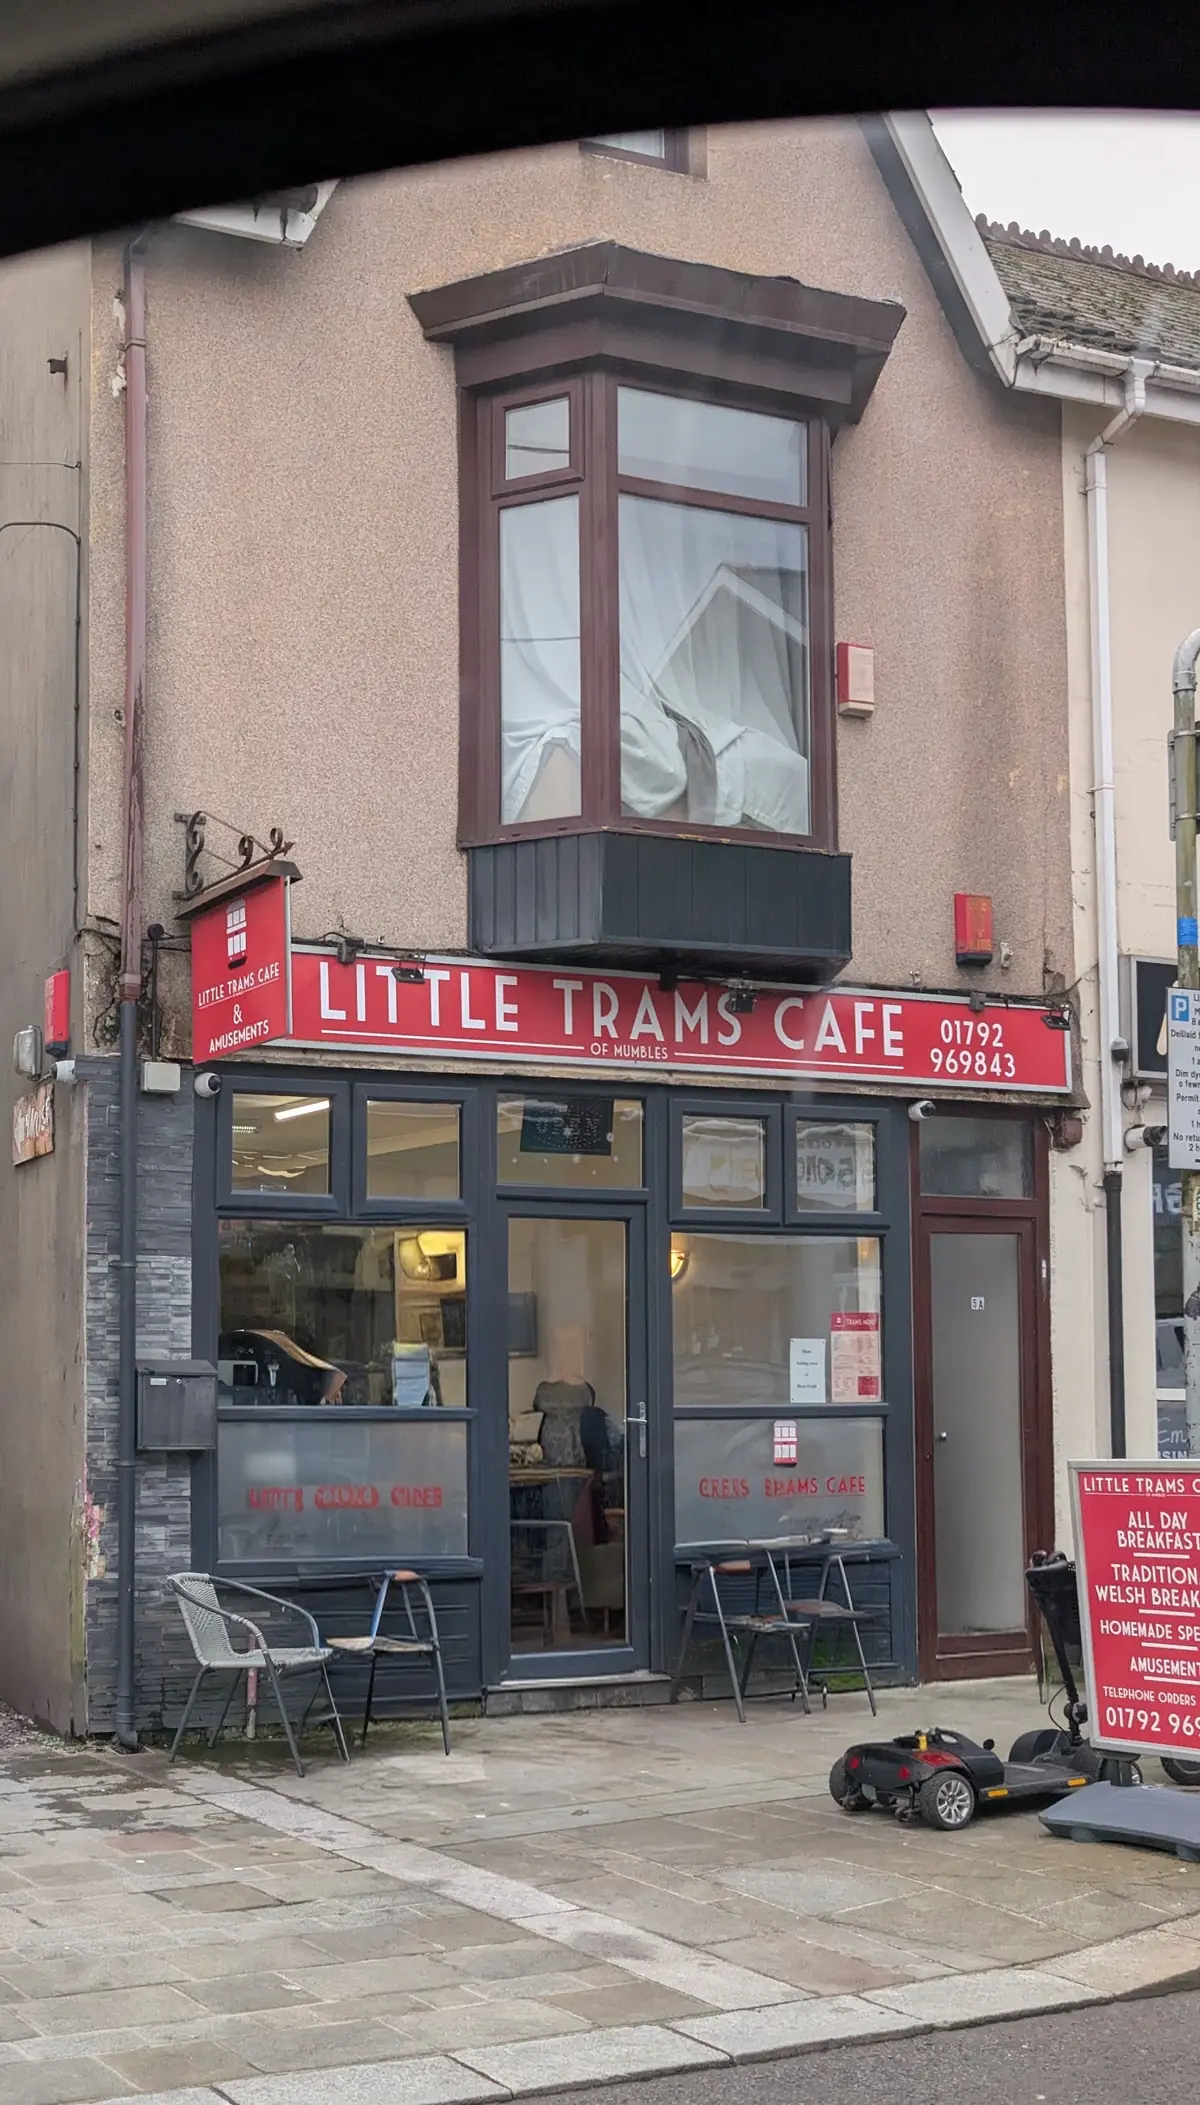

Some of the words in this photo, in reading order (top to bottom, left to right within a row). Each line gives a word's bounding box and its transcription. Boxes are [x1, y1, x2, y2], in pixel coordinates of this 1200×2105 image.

[198, 984, 224, 1007] LITTLE
[227, 972, 254, 995] TRAMS
[258, 962, 279, 983] CAFE
[233, 1004, 243, 1025] &
[319, 962, 518, 1032] LITTLE
[553, 979, 742, 1046] TRAMS
[774, 997, 904, 1057] CAFE
[209, 1019, 269, 1054] AMUSEMENTS
[941, 1019, 1004, 1048] 01792
[590, 1043, 609, 1056] OF
[614, 1045, 668, 1060] MUMBLES
[930, 1048, 1016, 1078] 969843
[1175, 1069, 1189, 1077] Dim
[1176, 1093, 1199, 1103] Permit
[1173, 1132, 1184, 1141] No
[826, 1475, 865, 1494] CAFE
[1083, 1477, 1129, 1492] LITTLE
[1135, 1478, 1185, 1493] TRAMS
[1128, 1511, 1154, 1529] ALL
[1160, 1511, 1188, 1530] DAY
[1095, 1584, 1146, 1605] WELSH
[1100, 1619, 1173, 1640] HOMEMADE
[1102, 1685, 1155, 1702] TELEPHONE
[1158, 1692, 1196, 1707] ORDERS
[1106, 1706, 1161, 1732] 01792
